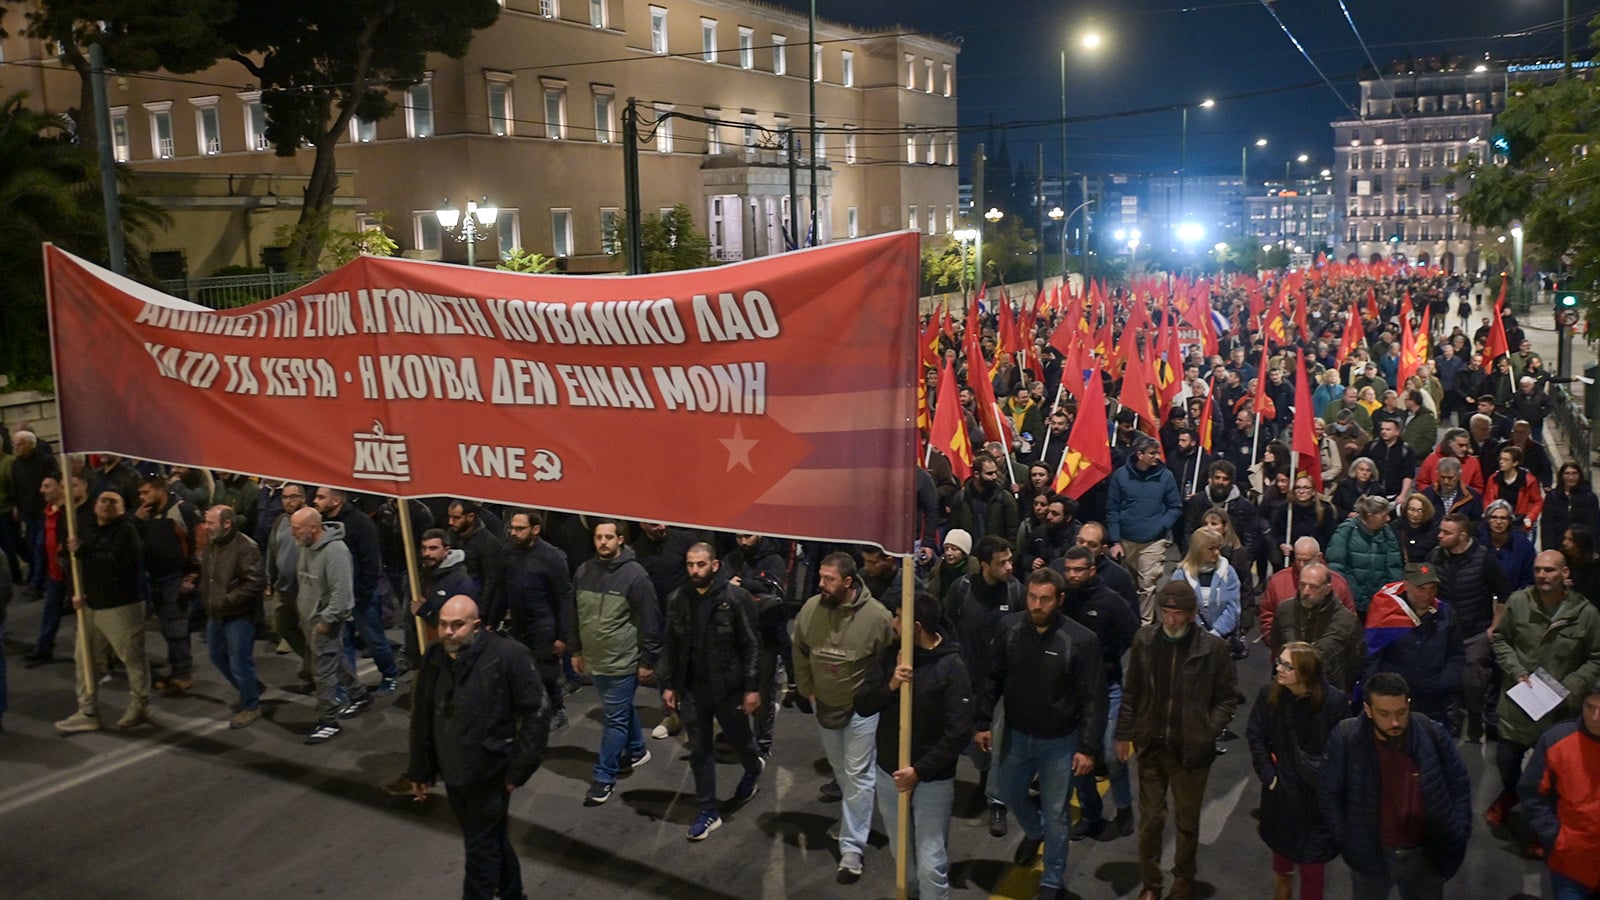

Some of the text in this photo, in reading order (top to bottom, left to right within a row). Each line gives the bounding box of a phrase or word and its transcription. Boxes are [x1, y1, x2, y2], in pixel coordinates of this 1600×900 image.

[301, 293, 356, 338] ΣΤΟΝ
[358, 289, 494, 338] ΑΓΩΝΙΣΤΗ
[487, 297, 685, 345] ΚΟΥΒΑΝΙΚΟ
[692, 290, 779, 342] ΛΑΟ
[223, 356, 259, 394] ΤΑ
[261, 357, 337, 398] ΧΕΡΙΑ
[358, 354, 379, 400] Η
[379, 354, 483, 403] ΚΟΥΒΑ
[491, 357, 558, 405] ΔΕΝ
[556, 363, 655, 409] ΕΙΝΑΙ
[652, 361, 765, 415] ΜΟΝΗ
[353, 442, 409, 475] ΚΚΕ
[458, 444, 526, 480] ΚΝΕ
